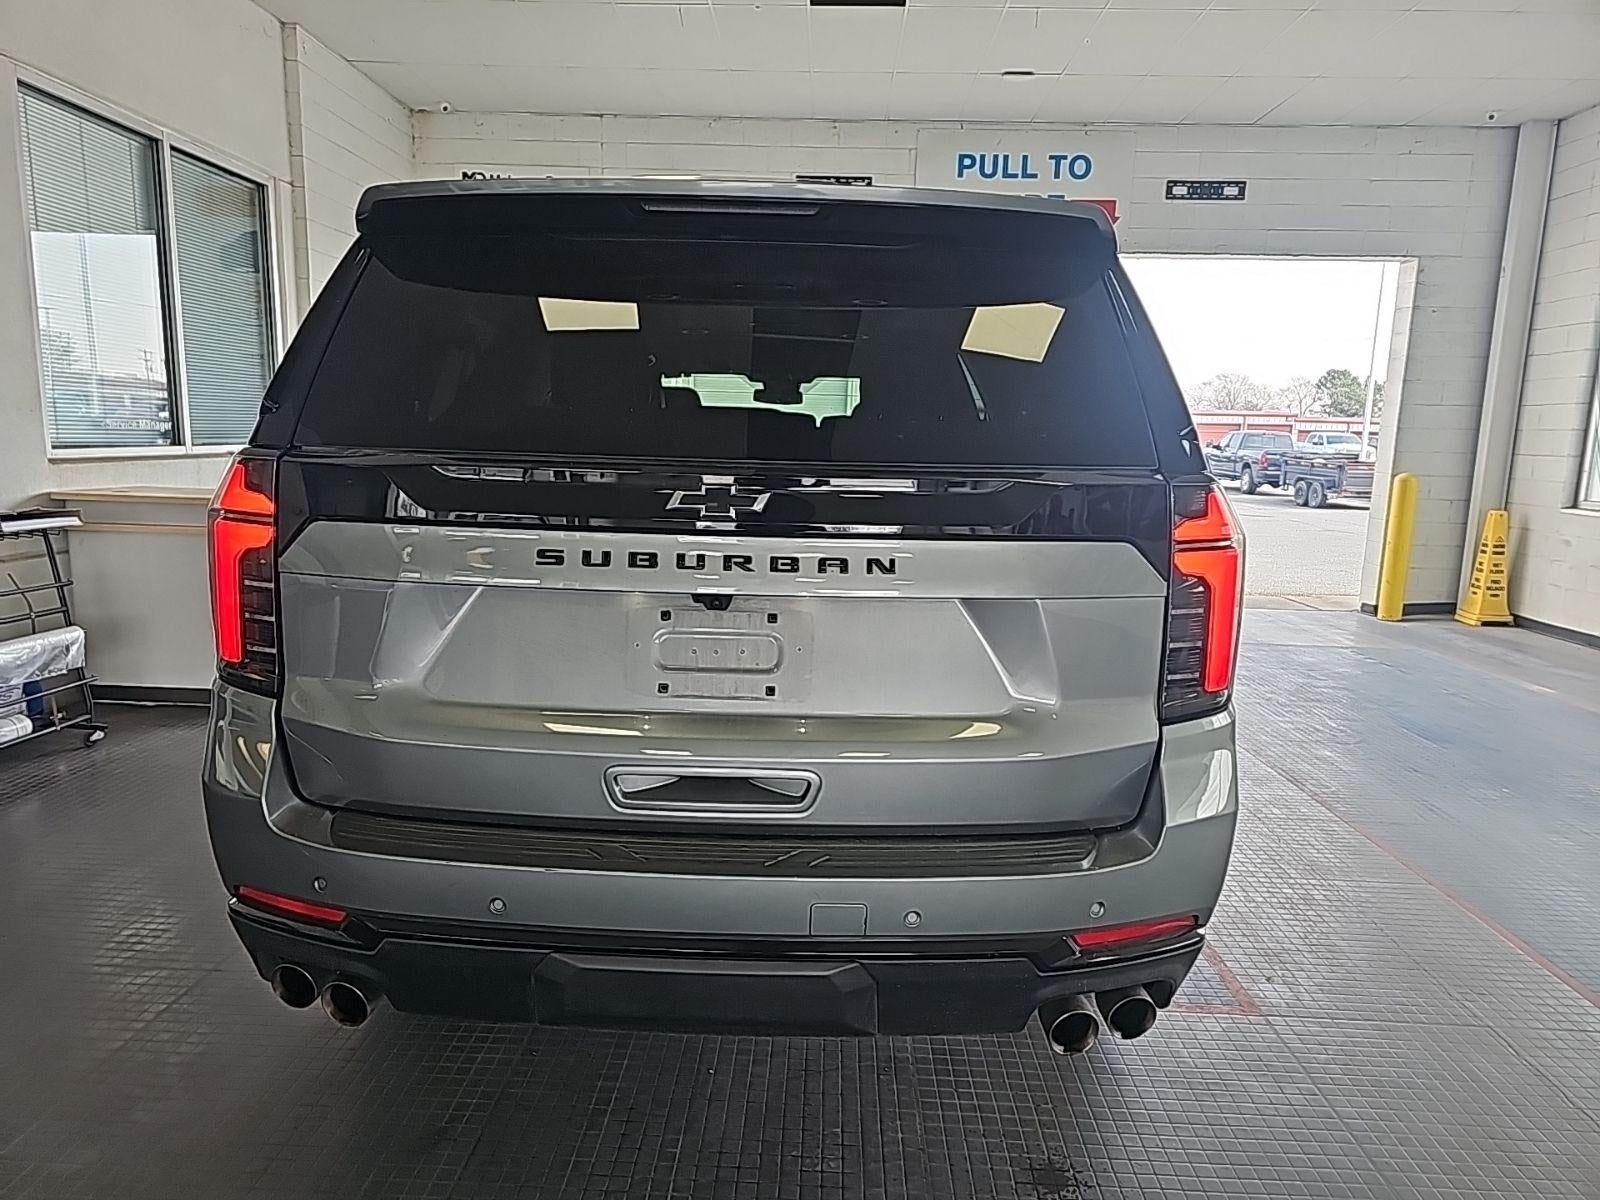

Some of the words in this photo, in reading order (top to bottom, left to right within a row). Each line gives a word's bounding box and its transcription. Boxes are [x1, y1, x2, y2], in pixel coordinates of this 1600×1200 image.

[956, 153, 1039, 179] PULL
[1048, 154, 1093, 180] TO
[105, 419, 138, 430] Service
[139, 419, 172, 432] Manager
[535, 548, 897, 575] SUBURBAN
